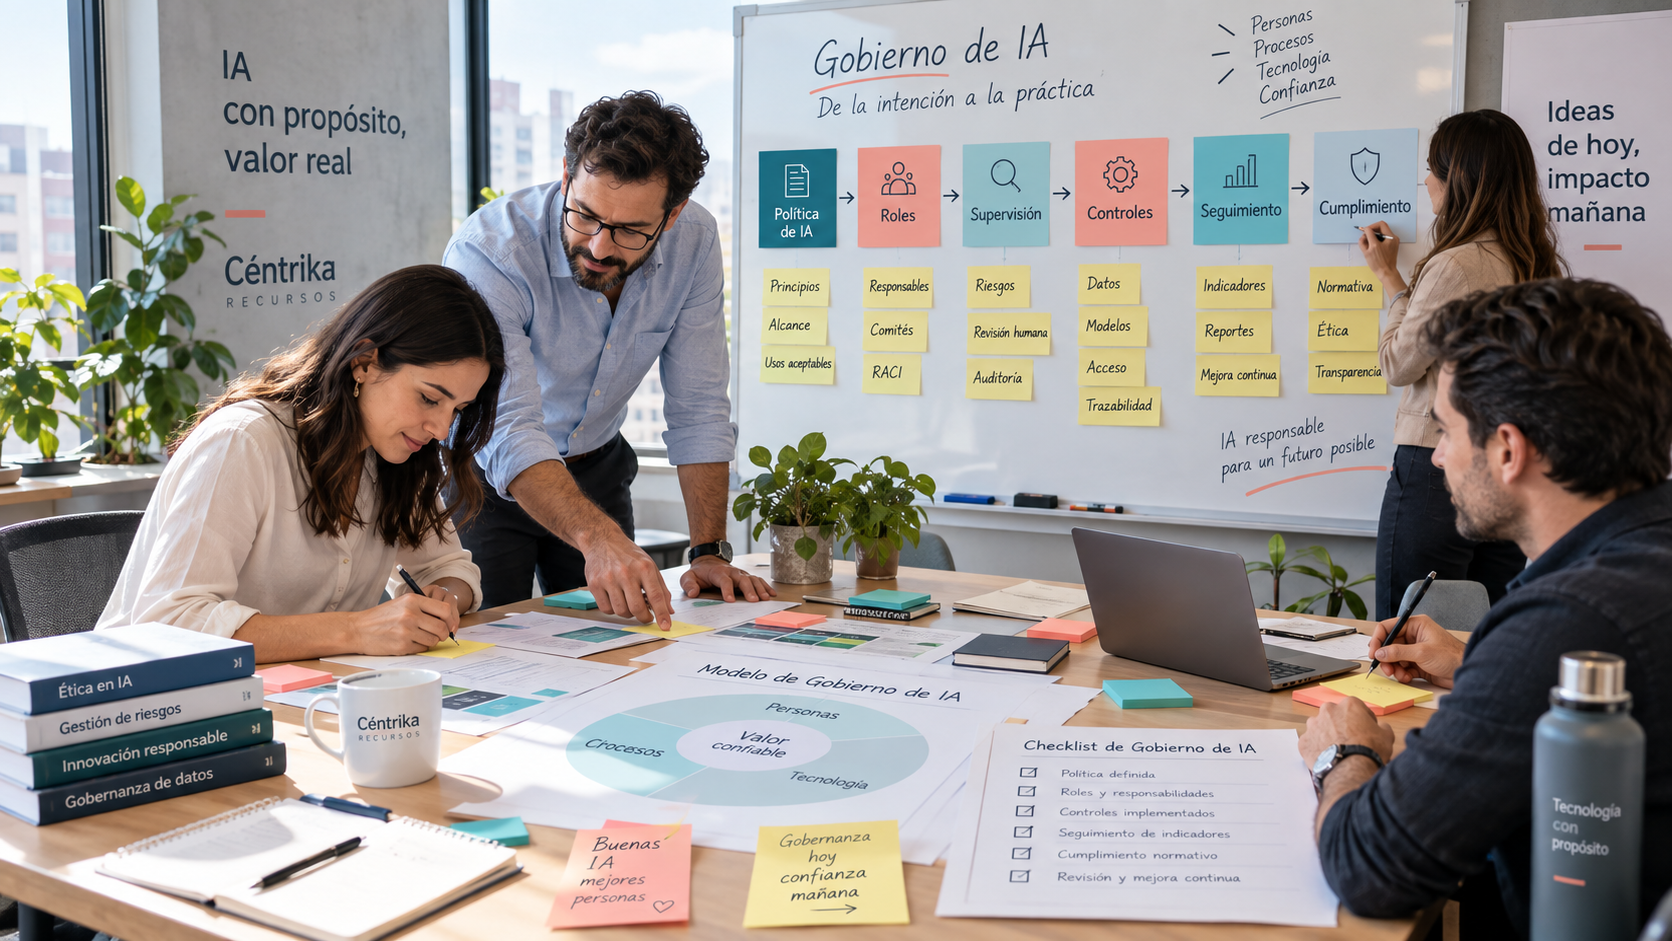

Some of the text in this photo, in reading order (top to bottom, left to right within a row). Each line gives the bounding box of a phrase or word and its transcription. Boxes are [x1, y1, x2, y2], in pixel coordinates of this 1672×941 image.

[1251, 10, 1313, 35] Personas
[815, 23, 1048, 79] Gobierno de IA
[1254, 32, 1314, 58] Procesos
[223, 50, 251, 81] IA
[817, 78, 1094, 118] De la intención a la práctica
[1259, 76, 1336, 104] Confianza
[1549, 100, 1614, 122] Ideas
[224, 102, 405, 139] con propósito,
[1548, 133, 1639, 159] de hoy,
[224, 142, 351, 174] valor real
[1549, 168, 1649, 194] impacto
[775, 207, 819, 220] Política
[882, 208, 915, 222] Roles
[971, 206, 1042, 222] Supervisión
[1088, 205, 1153, 219] Controles
[1201, 203, 1281, 221] Seguimiento
[1320, 199, 1411, 218] Cumplimiento
[1548, 200, 1646, 223] mañana
[781, 225, 812, 237] de IA
[225, 254, 335, 286] Céntrika
[771, 279, 819, 296] Principios
[870, 279, 929, 296] Responsables
[976, 279, 1014, 296] Riesgos
[1087, 276, 1120, 290] Datos
[1204, 278, 1265, 291] Indicadores
[1317, 280, 1373, 293] Normativa
[227, 291, 337, 309] RECURSOS
[769, 318, 810, 330] Alcance
[871, 323, 913, 336] Comités
[974, 325, 1047, 338] Revisión humana
[1086, 318, 1130, 331] Modelos
[1318, 321, 1348, 337] Ética
[1205, 324, 1253, 342] Reportes
[765, 357, 831, 372] Usos aceptables
[873, 365, 902, 378] RACI
[1087, 360, 1126, 373] Acceso
[973, 371, 1022, 383] Auditoría
[1201, 368, 1277, 385] Mejora continua
[1315, 365, 1382, 382] Transparencia
[1086, 398, 1152, 411] Trazabilidad
[1222, 416, 1324, 449] IA responsable
[1222, 433, 1375, 483] para un futuro posible
[59, 675, 132, 698] Ética en IA
[698, 664, 960, 702] Modelo de Gobierno de IA
[60, 703, 182, 734] Gestión de riesgos
[766, 703, 839, 719] Personas
[358, 714, 419, 730] Céntrika
[359, 731, 419, 741] RECURSOS
[739, 730, 790, 746] Valor
[63, 730, 227, 772] Innovación responsable
[711, 740, 787, 759] confiable
[1024, 740, 1256, 753] Checklist de Gobierno de IA
[791, 771, 868, 789] Tecnología
[65, 768, 214, 809] Gobernanza de datos
[1061, 788, 1093, 796] Roles
[1113, 790, 1214, 799] responsabilidades
[1060, 808, 1215, 819] Controles implementados
[1552, 797, 1621, 822] Tecnología
[1059, 828, 1135, 840] Seguimiento
[1163, 830, 1230, 838] indicadores
[1552, 820, 1578, 834] con
[593, 837, 660, 851] Buenas
[780, 833, 870, 847] Gobernanza
[1552, 838, 1609, 856] propósito
[589, 856, 613, 869] IA
[809, 850, 836, 866] hoy
[1058, 850, 1146, 861] Cumplimiento
[579, 873, 646, 891] mejores
[781, 868, 866, 884] confianza
[1058, 872, 1240, 884] Revisión y mejora continua
[571, 894, 645, 909] personas
